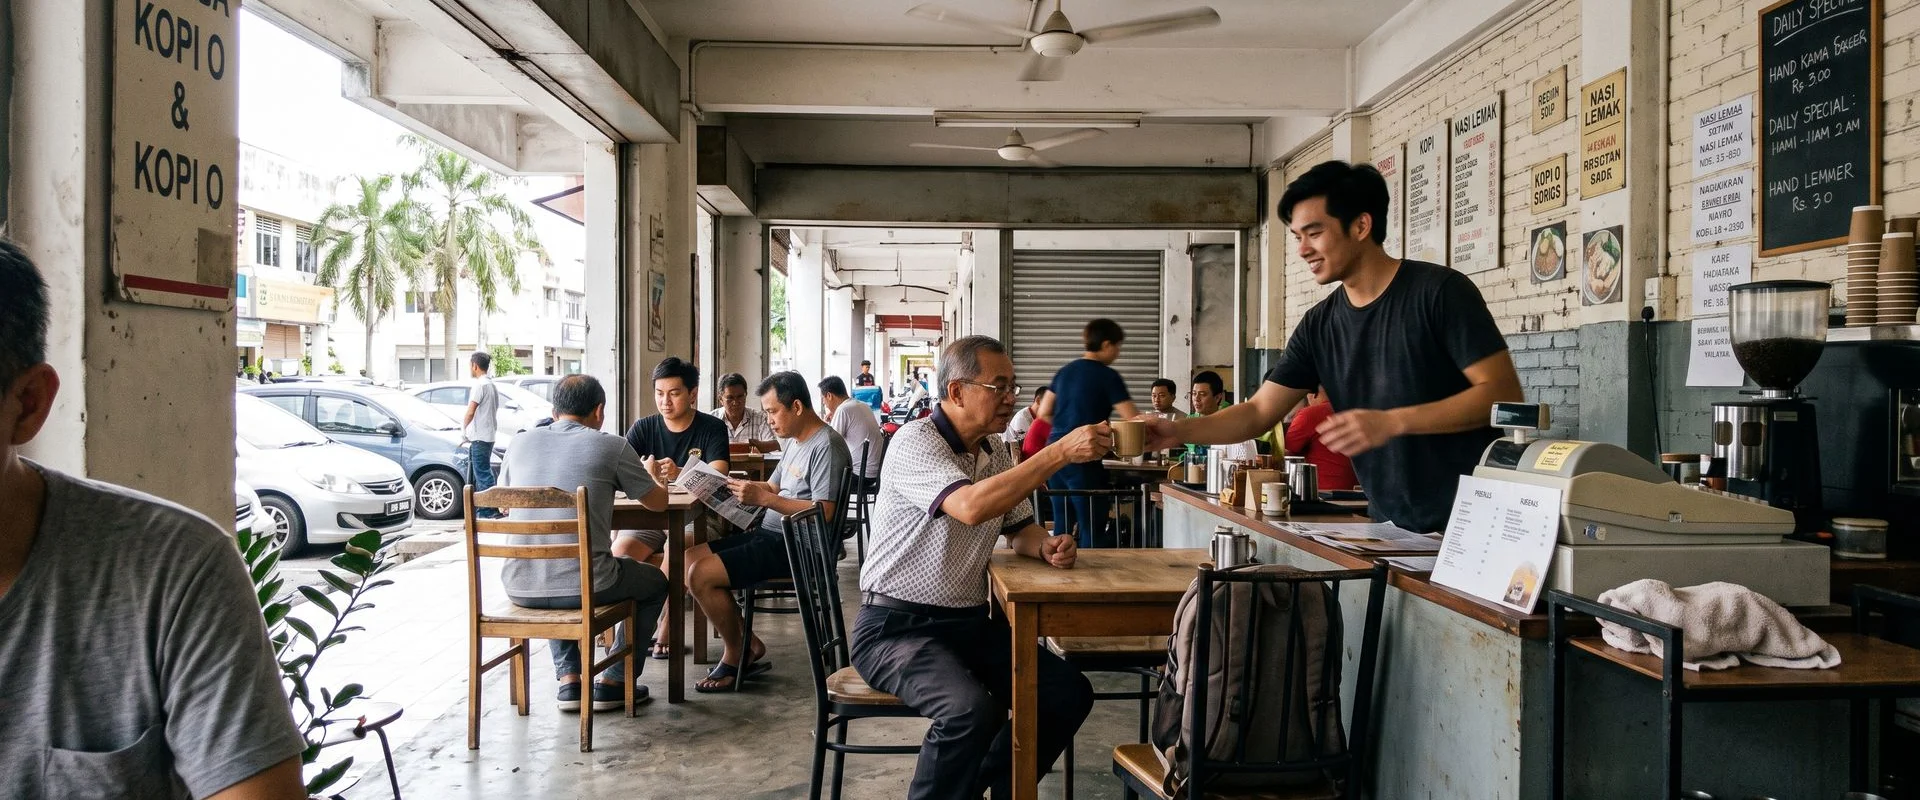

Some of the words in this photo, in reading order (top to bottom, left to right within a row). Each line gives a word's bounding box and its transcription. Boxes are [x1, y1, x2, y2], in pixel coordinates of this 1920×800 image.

[1774, 6, 1804, 36] DAILY
[1809, 0, 1855, 19] SPEC
[135, 0, 199, 71] KOPI
[208, 34, 225, 81] O
[1769, 60, 1797, 83] HAND
[1801, 46, 1829, 70] KAMA
[1808, 68, 1831, 87] 3.00
[171, 81, 189, 131] &
[1590, 82, 1615, 107] NASI
[1455, 115, 1471, 137] NASI
[1472, 102, 1497, 129] LEMAK
[1585, 98, 1621, 127] LEMAK
[1699, 112, 1717, 126] NASI
[1769, 111, 1799, 136] DAILY
[1419, 135, 1435, 155] KOPI
[1699, 141, 1717, 154] NASI
[1717, 132, 1743, 148] LEMAK
[134, 141, 198, 204] KOPI
[206, 164, 224, 210] O
[1534, 168, 1553, 188] KOPI
[1554, 165, 1561, 181] O
[1769, 176, 1799, 198] HAND
[1804, 162, 1855, 189] LEMMER
